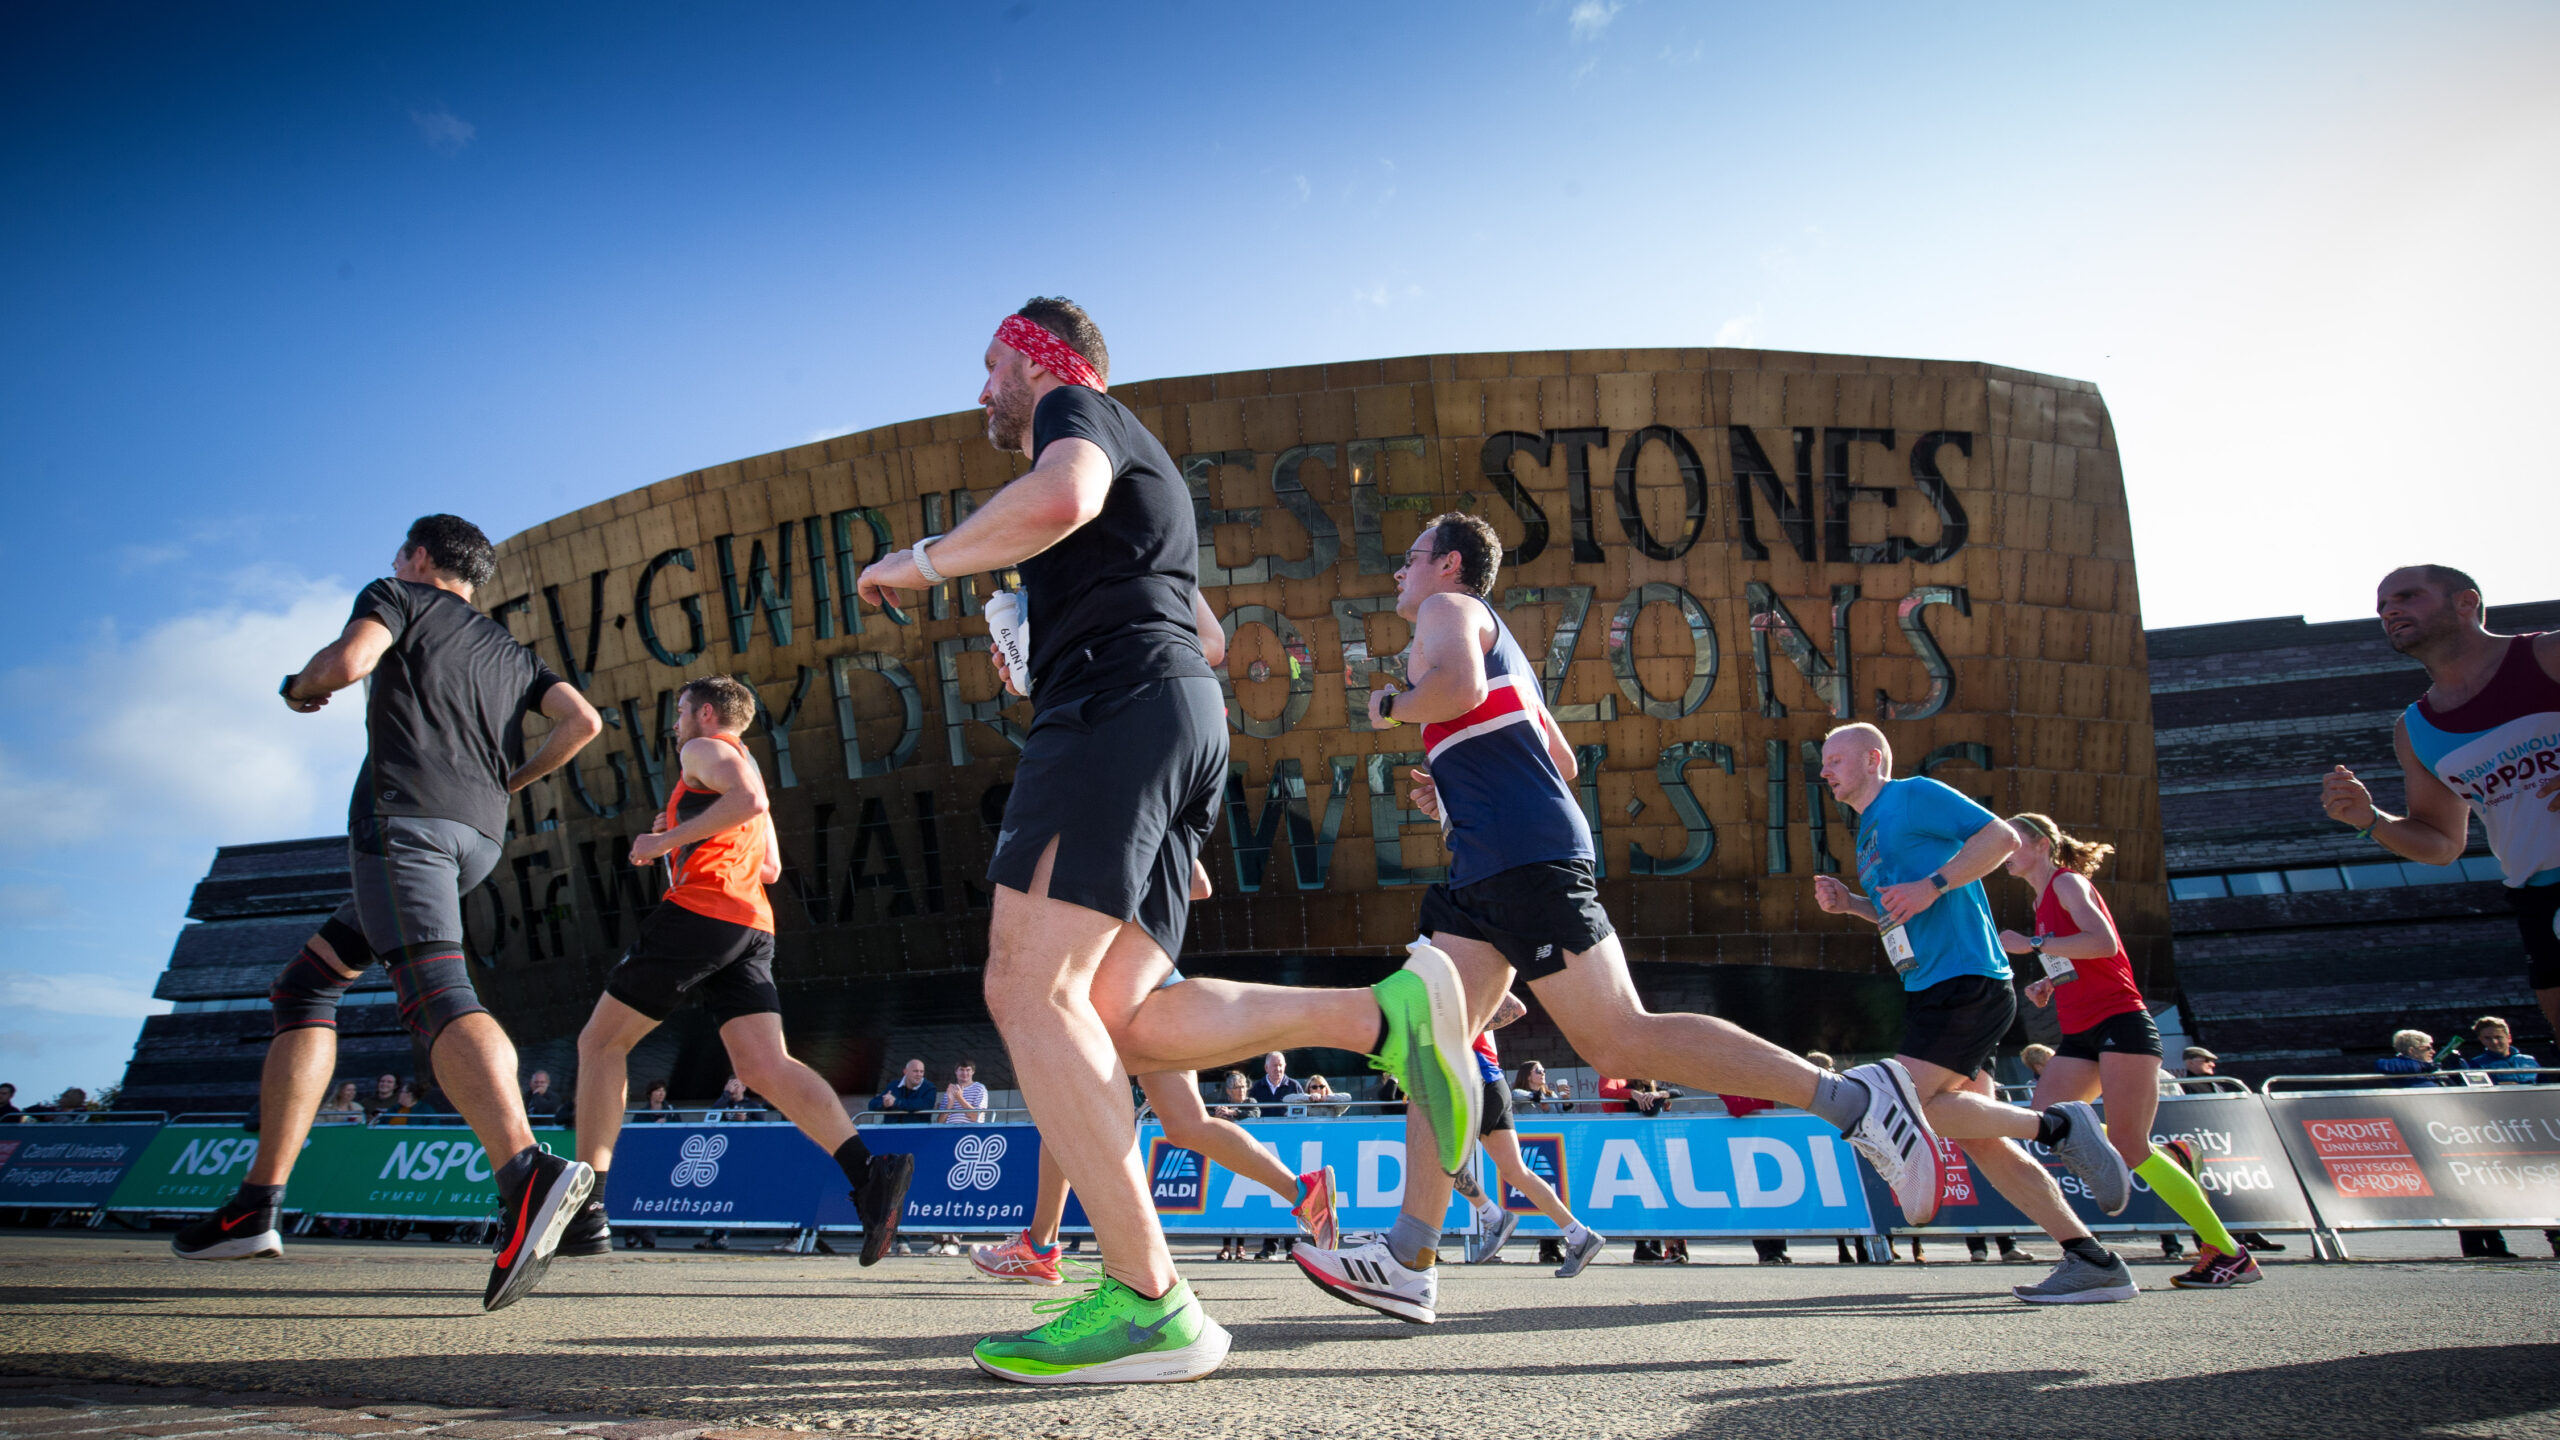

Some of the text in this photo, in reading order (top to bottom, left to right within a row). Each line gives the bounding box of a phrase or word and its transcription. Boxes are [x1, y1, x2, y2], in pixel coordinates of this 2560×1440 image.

[633, 506, 913, 668] GWIR
[1481, 424, 1973, 566] STONES
[1215, 580, 1973, 740] ORZONS
[2459, 733, 2560, 784] BRAIN TUMOU
[2311, 1121, 2393, 1142] CARDIFF
[2427, 1118, 2537, 1146] Cardiff
[2321, 1141, 2399, 1153] UNIVERSITY
[378, 1140, 492, 1183] NSPC
[1587, 1135, 1848, 1209] ALDI
[2332, 1162, 2412, 1174] PRIFYSGOL
[2447, 1159, 2560, 1191] Prifysg
[157, 1184, 208, 1197] CYMRU
[369, 1190, 500, 1205] CYMRU WALE
[1154, 1183, 1197, 1198] ALDI
[632, 1197, 735, 1216] healthspan
[907, 1201, 1023, 1220] healthspan
